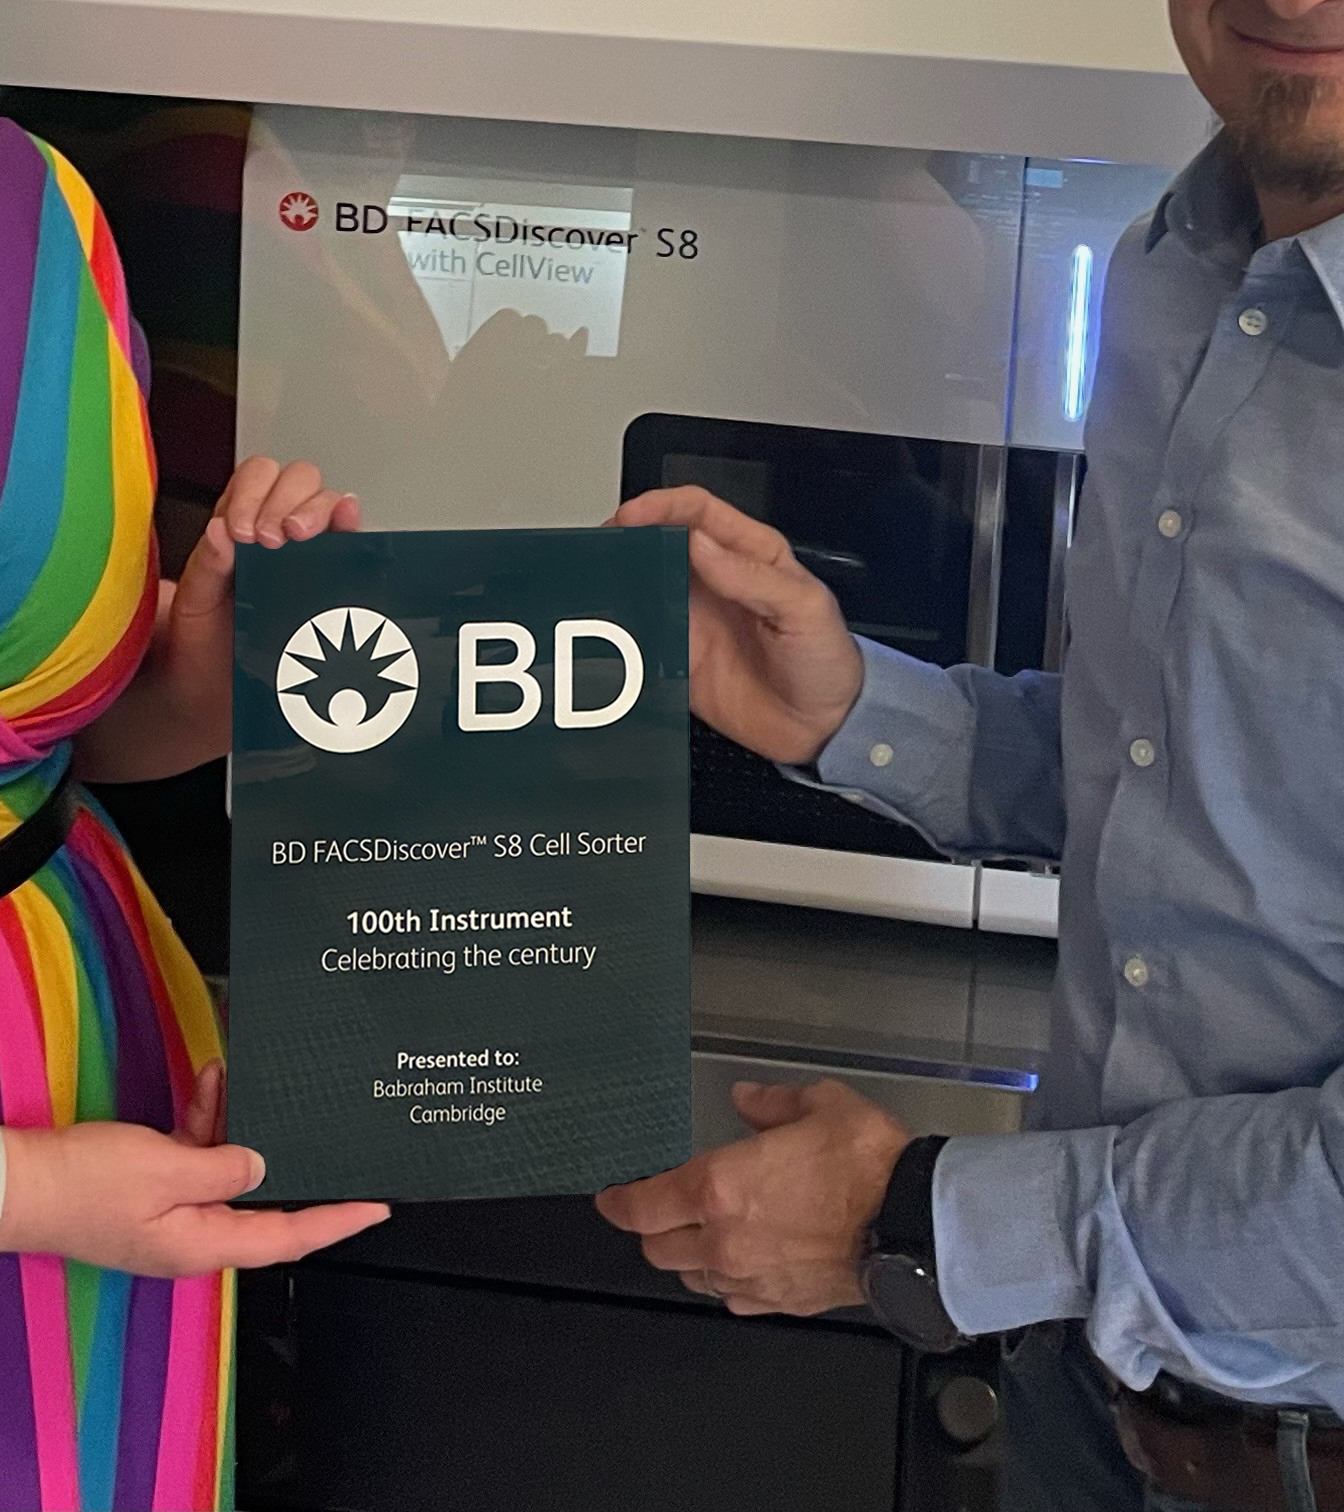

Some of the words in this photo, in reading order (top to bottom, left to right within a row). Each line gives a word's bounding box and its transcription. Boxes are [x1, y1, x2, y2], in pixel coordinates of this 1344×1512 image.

[335, 202, 388, 234] BD
[656, 227, 699, 260] S8
[408, 248, 466, 276] with
[475, 251, 594, 285] CellView
[458, 619, 645, 732] BD
[271, 840, 307, 865] BD
[494, 835, 523, 858] S8
[529, 832, 571, 856] Cell
[577, 831, 647, 855] Sorter
[346, 909, 421, 935] 100th
[429, 905, 573, 933] Instrument
[321, 945, 456, 974] Celebrating
[463, 944, 502, 967] the
[508, 942, 597, 969] century
[397, 1049, 489, 1069] Presented
[494, 1050, 520, 1066] to:
[373, 1078, 464, 1098] Babraham
[469, 1076, 543, 1094] Institute
[409, 1103, 506, 1126] Cambridge
